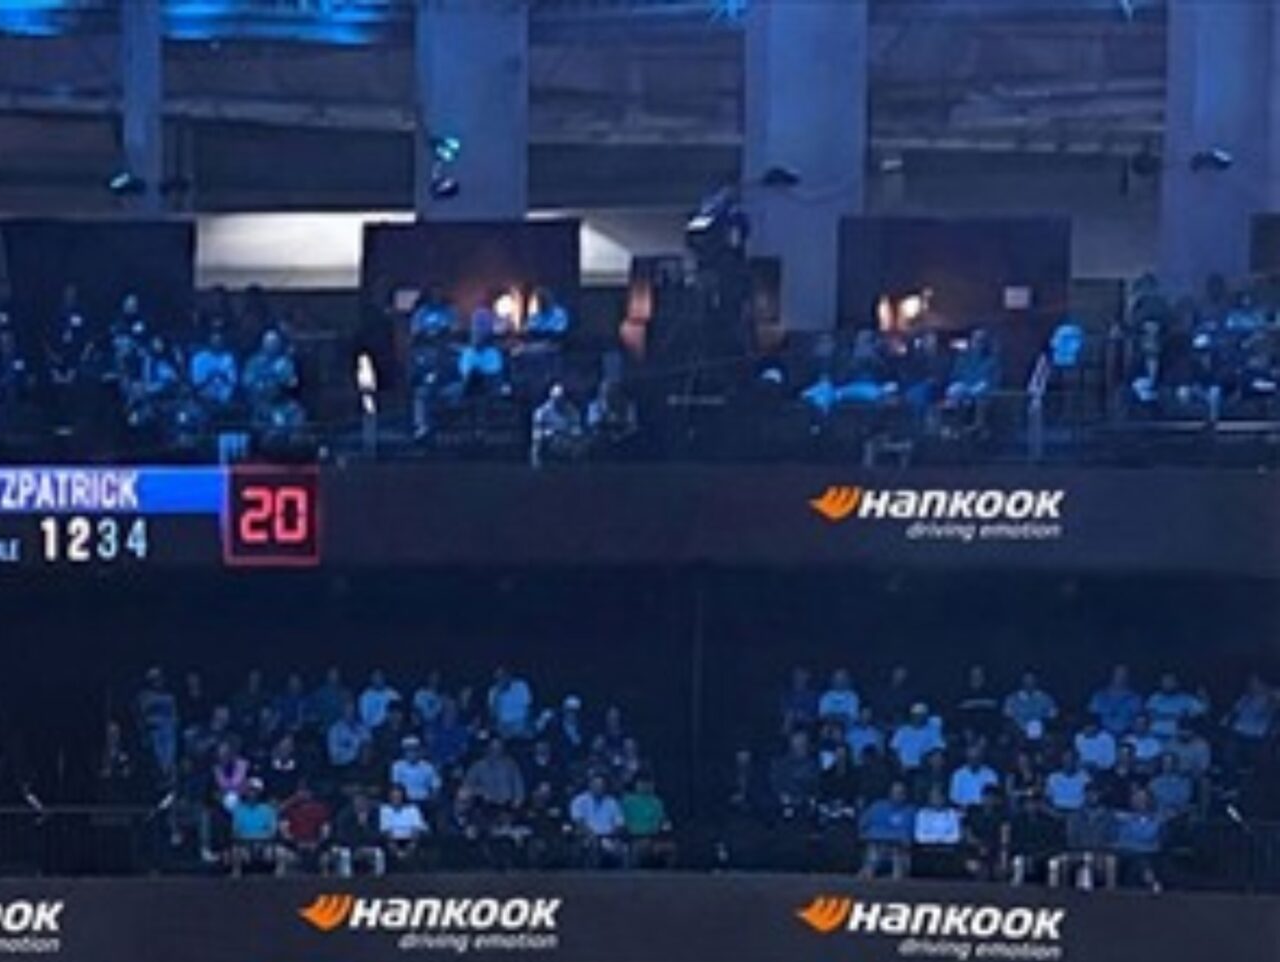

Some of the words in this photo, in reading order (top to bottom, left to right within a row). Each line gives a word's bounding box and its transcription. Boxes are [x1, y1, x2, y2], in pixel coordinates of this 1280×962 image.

[239, 487, 308, 543] 20
[905, 522, 975, 542] driving
[398, 932, 468, 952] driving
[897, 937, 971, 960] driving
